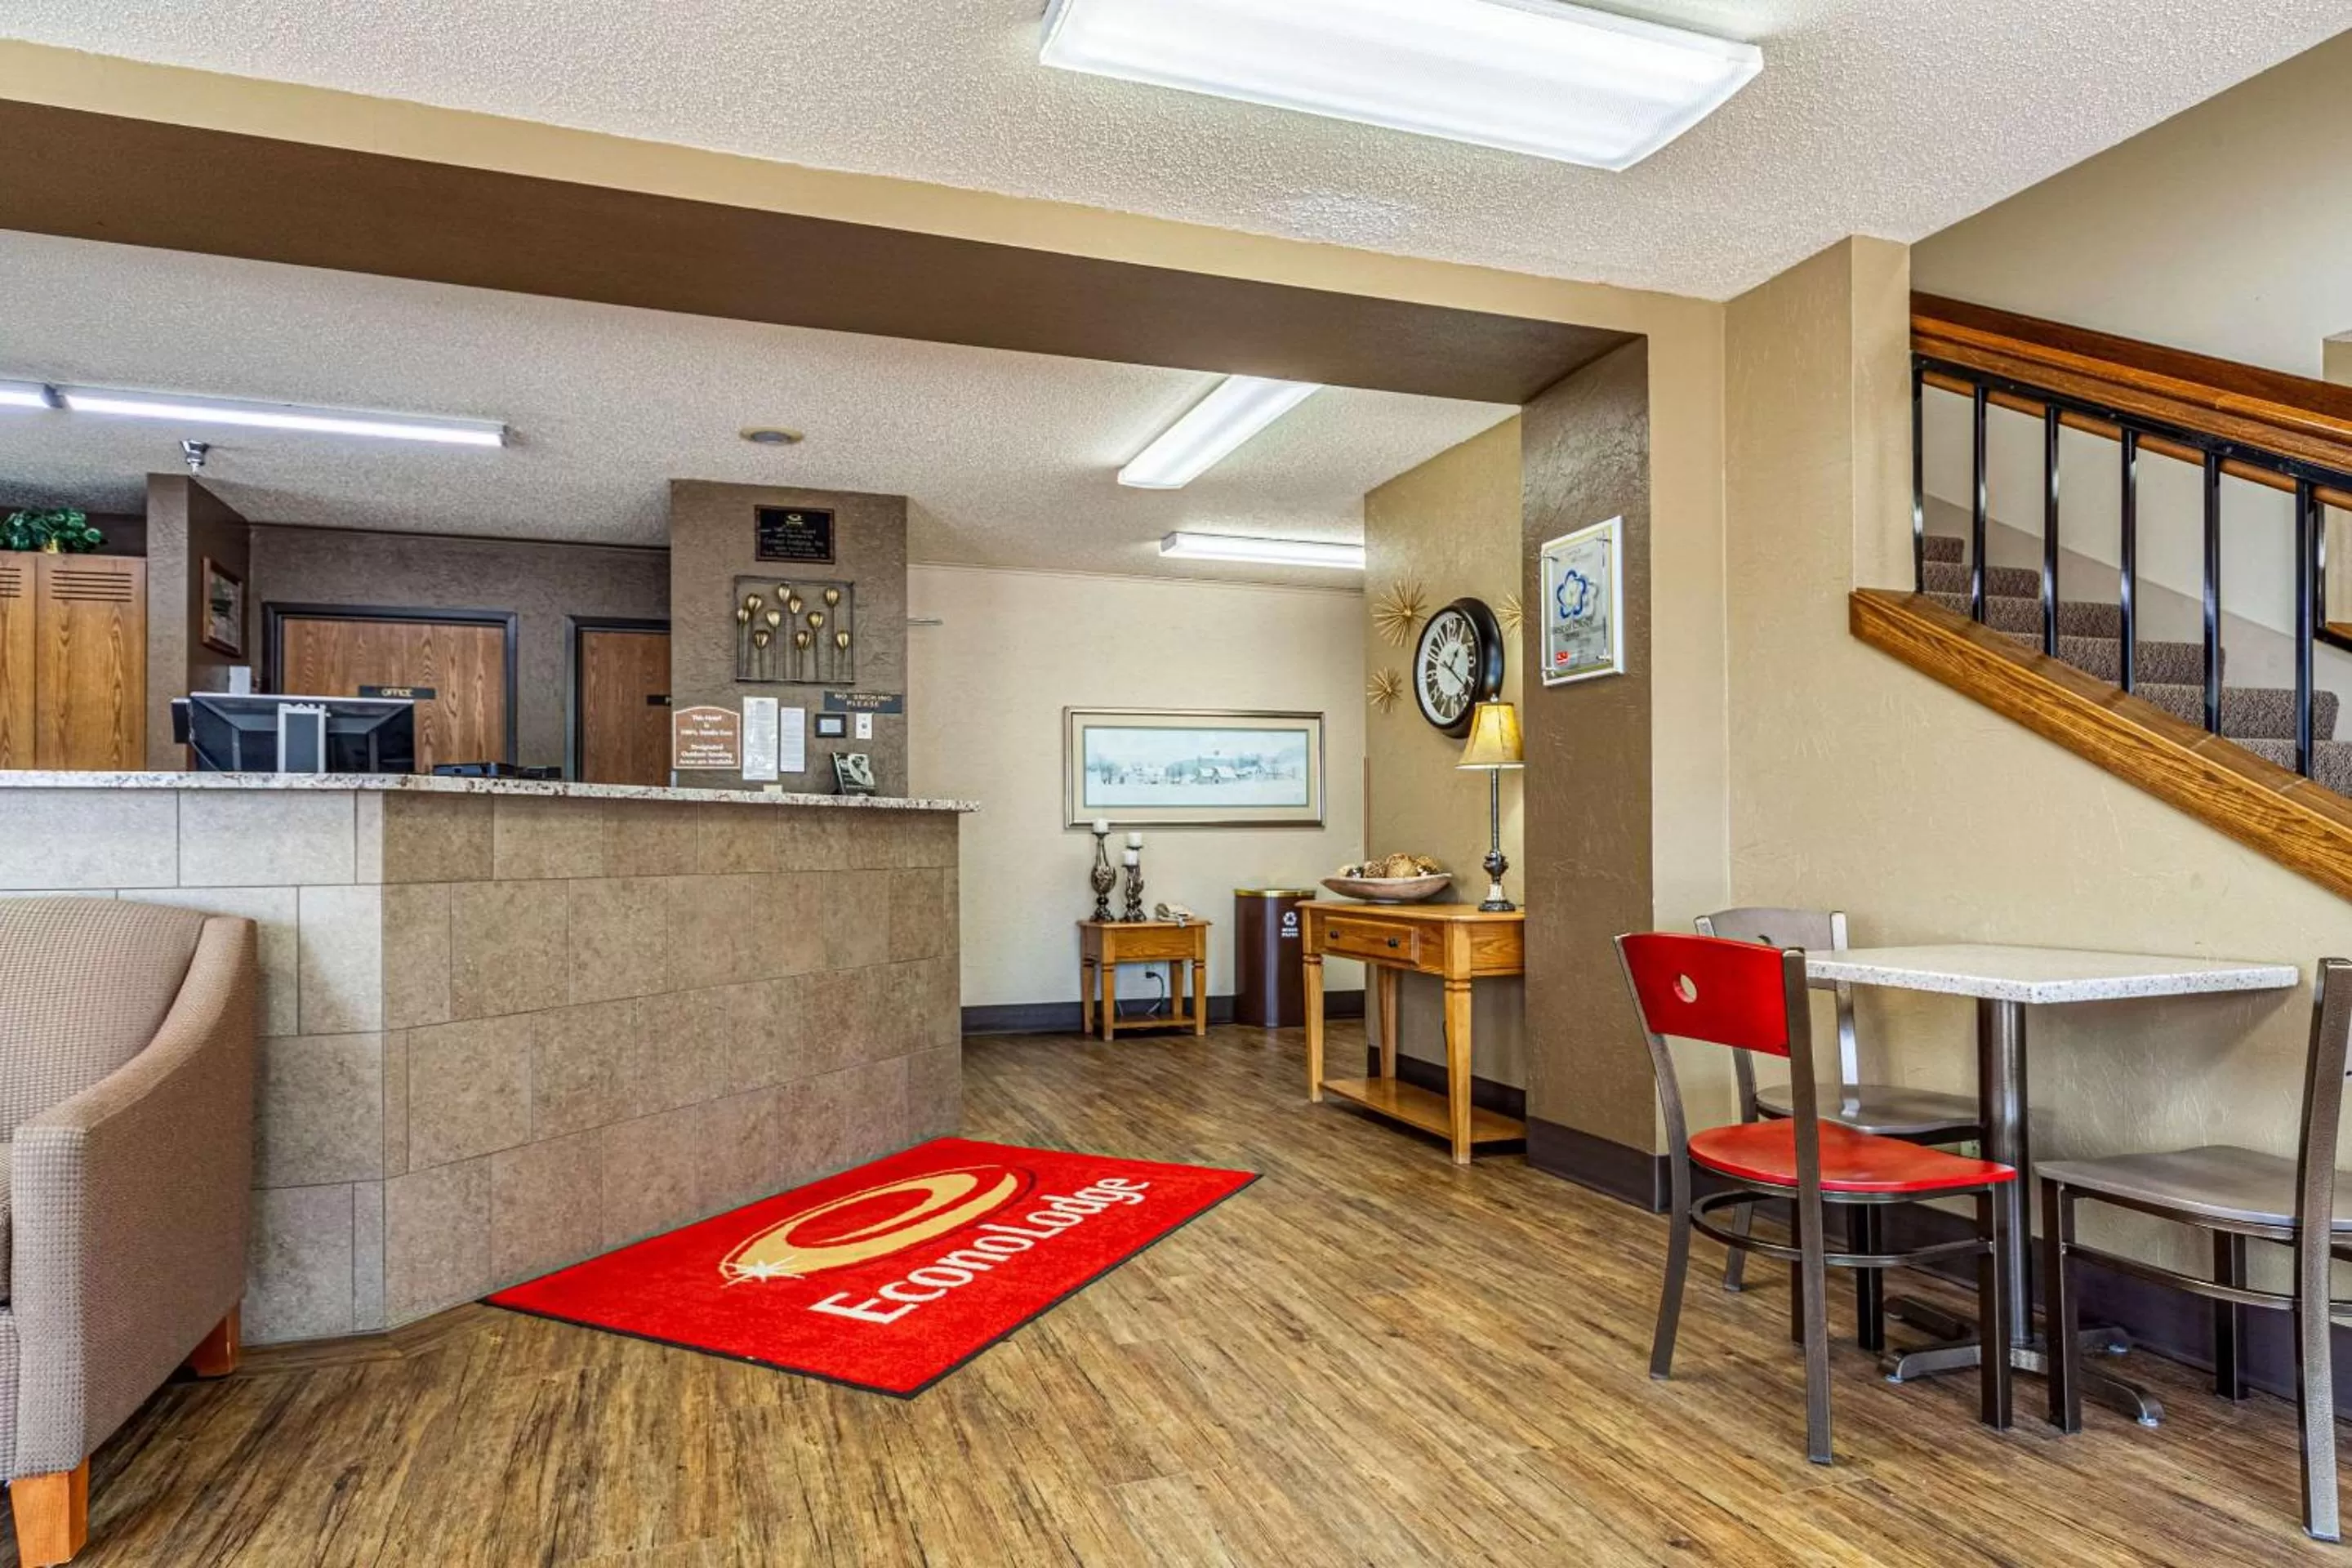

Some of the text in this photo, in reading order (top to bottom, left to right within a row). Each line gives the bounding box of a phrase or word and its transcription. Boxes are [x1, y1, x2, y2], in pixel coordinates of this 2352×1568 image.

[381, 688, 413, 697] OFFICE
[853, 693, 893, 702] SMOKING
[808, 1177, 1150, 1324] EconoLodge
